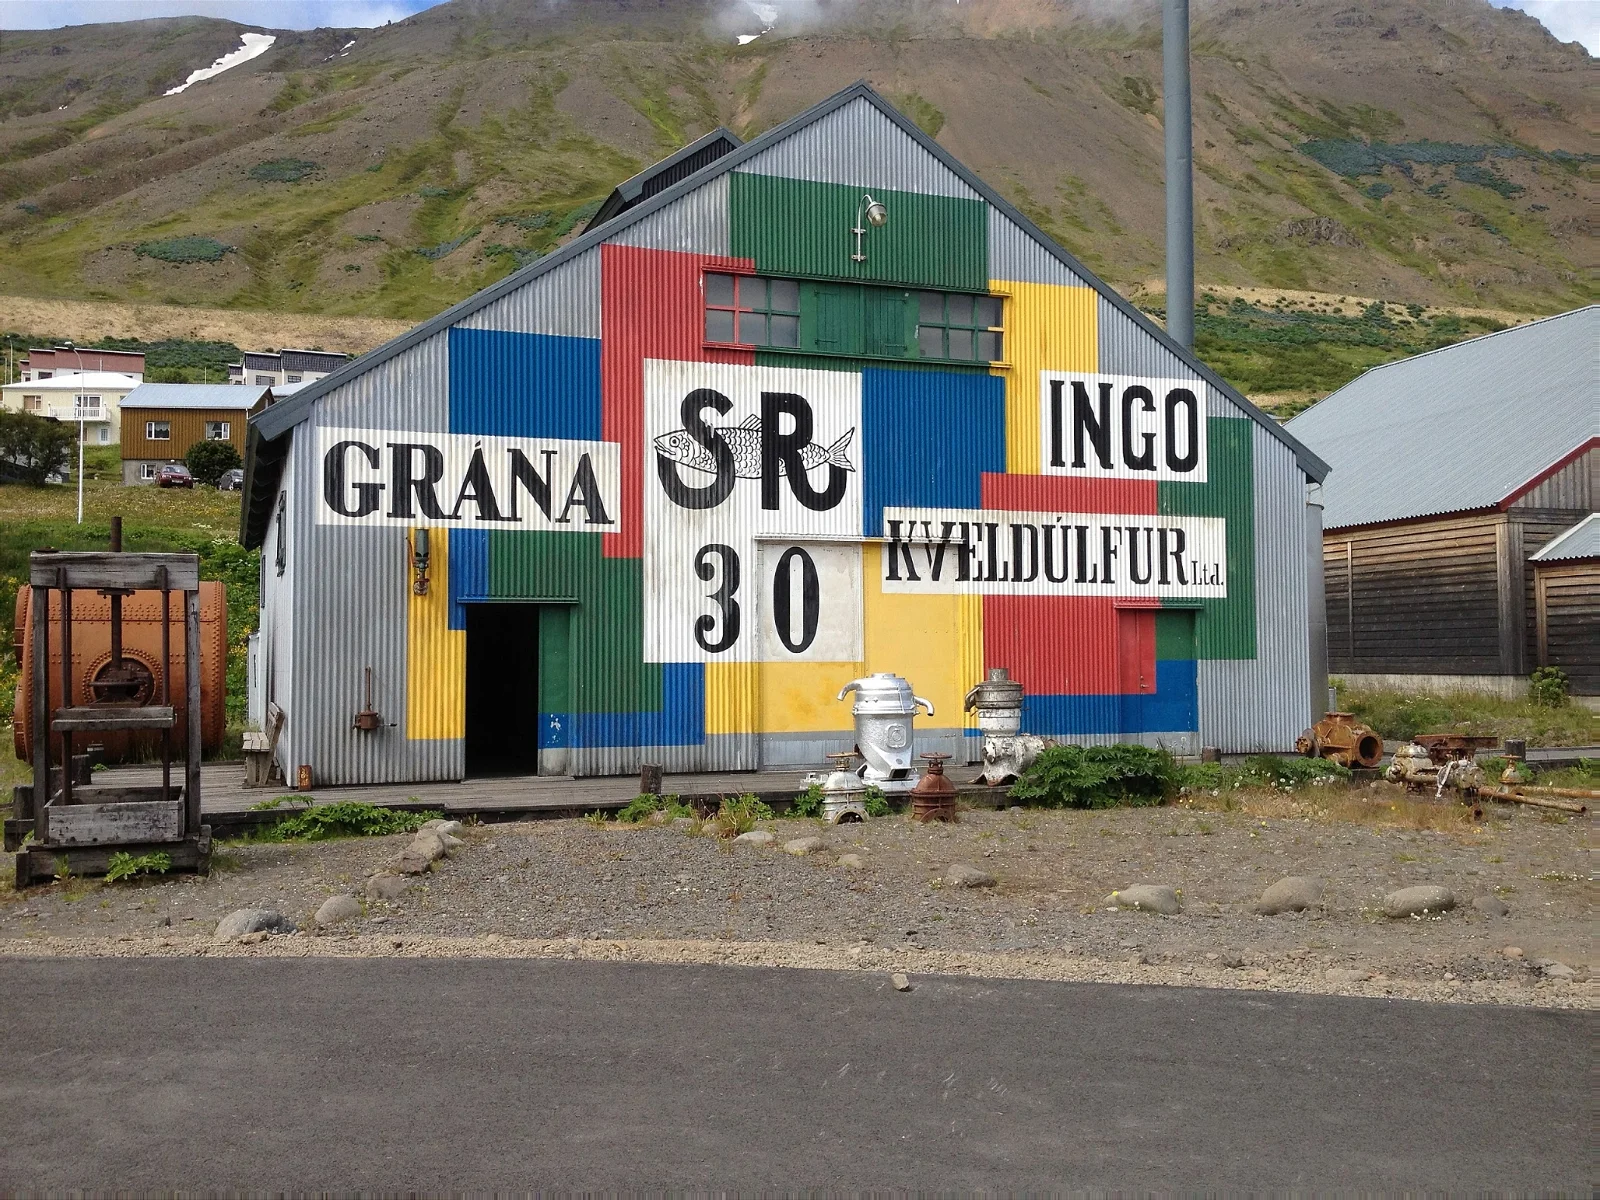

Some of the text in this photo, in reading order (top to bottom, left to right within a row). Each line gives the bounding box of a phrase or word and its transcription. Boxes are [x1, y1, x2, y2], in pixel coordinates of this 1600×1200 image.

[657, 388, 848, 511] SR
[1049, 379, 1199, 473] INGO
[323, 440, 615, 525] GRÁNA
[885, 517, 1224, 586] KVELDÚLFUR Ltd.
